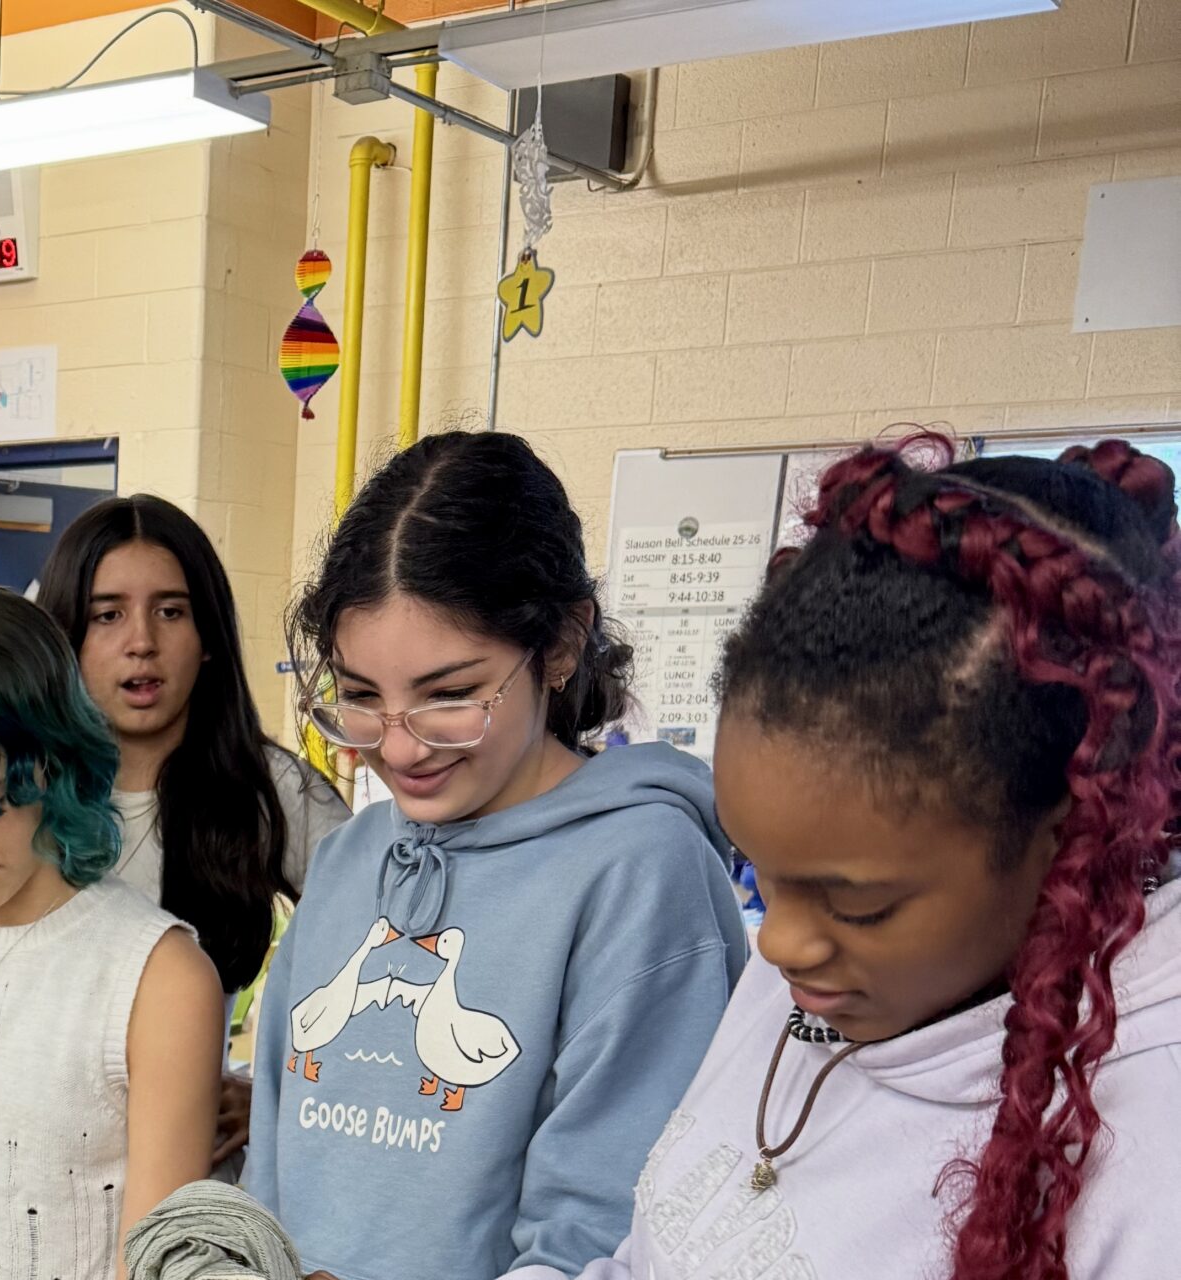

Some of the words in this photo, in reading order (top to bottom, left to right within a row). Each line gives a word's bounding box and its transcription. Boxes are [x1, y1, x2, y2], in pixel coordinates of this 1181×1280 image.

[509, 277, 537, 315] 1
[625, 539, 663, 550] Slauson
[664, 537, 684, 549] Bell
[685, 534, 730, 548] Schedule
[732, 534, 761, 546] 25-26
[623, 554, 667, 564] ADVISORY
[671, 552, 723, 565] 8:15-8:40
[669, 572, 721, 584] 8:45-9:39
[668, 591, 725, 604] 9:44-10:38
[664, 671, 695, 680] LUNCH
[660, 693, 709, 705] 1:10-2:04
[659, 712, 708, 724] 2:09-3:03
